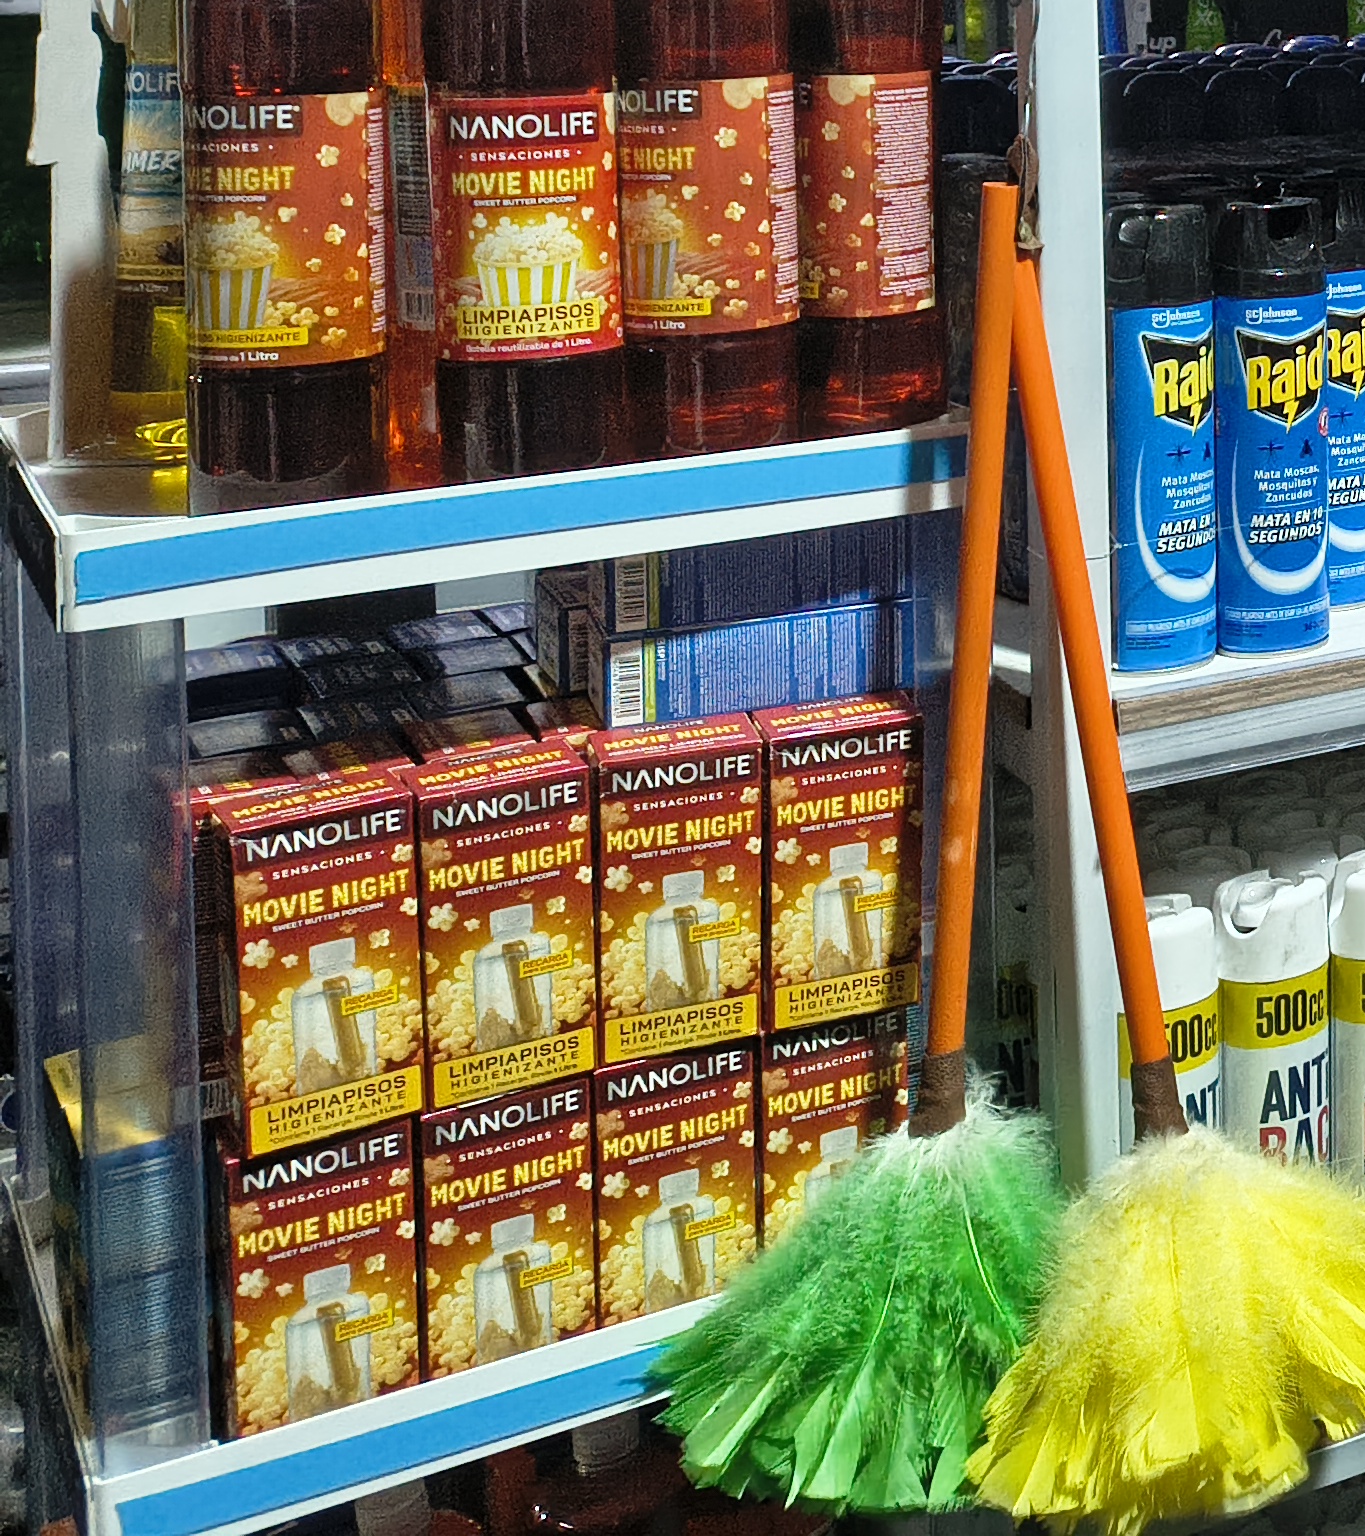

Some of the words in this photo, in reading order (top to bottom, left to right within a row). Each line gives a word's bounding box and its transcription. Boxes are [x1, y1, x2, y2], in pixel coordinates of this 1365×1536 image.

[450, 110, 594, 140] NANOLIFE
[470, 148, 571, 162] SENSACIONES
[451, 169, 522, 197] MOVIE
[528, 166, 596, 194] NIGHT
[460, 302, 596, 326] LIMPIAPISOS
[463, 318, 596, 337] HIGIENIZANTE
[1247, 336, 1324, 412] Raid
[1254, 469, 1282, 480] Mata
[1266, 488, 1313, 503] Zancudos
[1251, 512, 1290, 529] MATA
[1292, 511, 1310, 526] EN
[1312, 508, 1323, 524] 10
[611, 754, 751, 795] NANOLIFE
[245, 809, 401, 862] NANOLIFE
[605, 822, 678, 854] MOVIE
[685, 809, 756, 841] NIGHT
[272, 850, 372, 881] SENSACIONES
[243, 887, 324, 929] MOVIE
[332, 868, 410, 908] NIGHT
[448, 1036, 580, 1079] LIMPIAPISOS
[450, 1050, 580, 1090] HIGIENIZANTE
[429, 1167, 507, 1209] MOVIE
[511, 1146, 586, 1187] NIGHT
